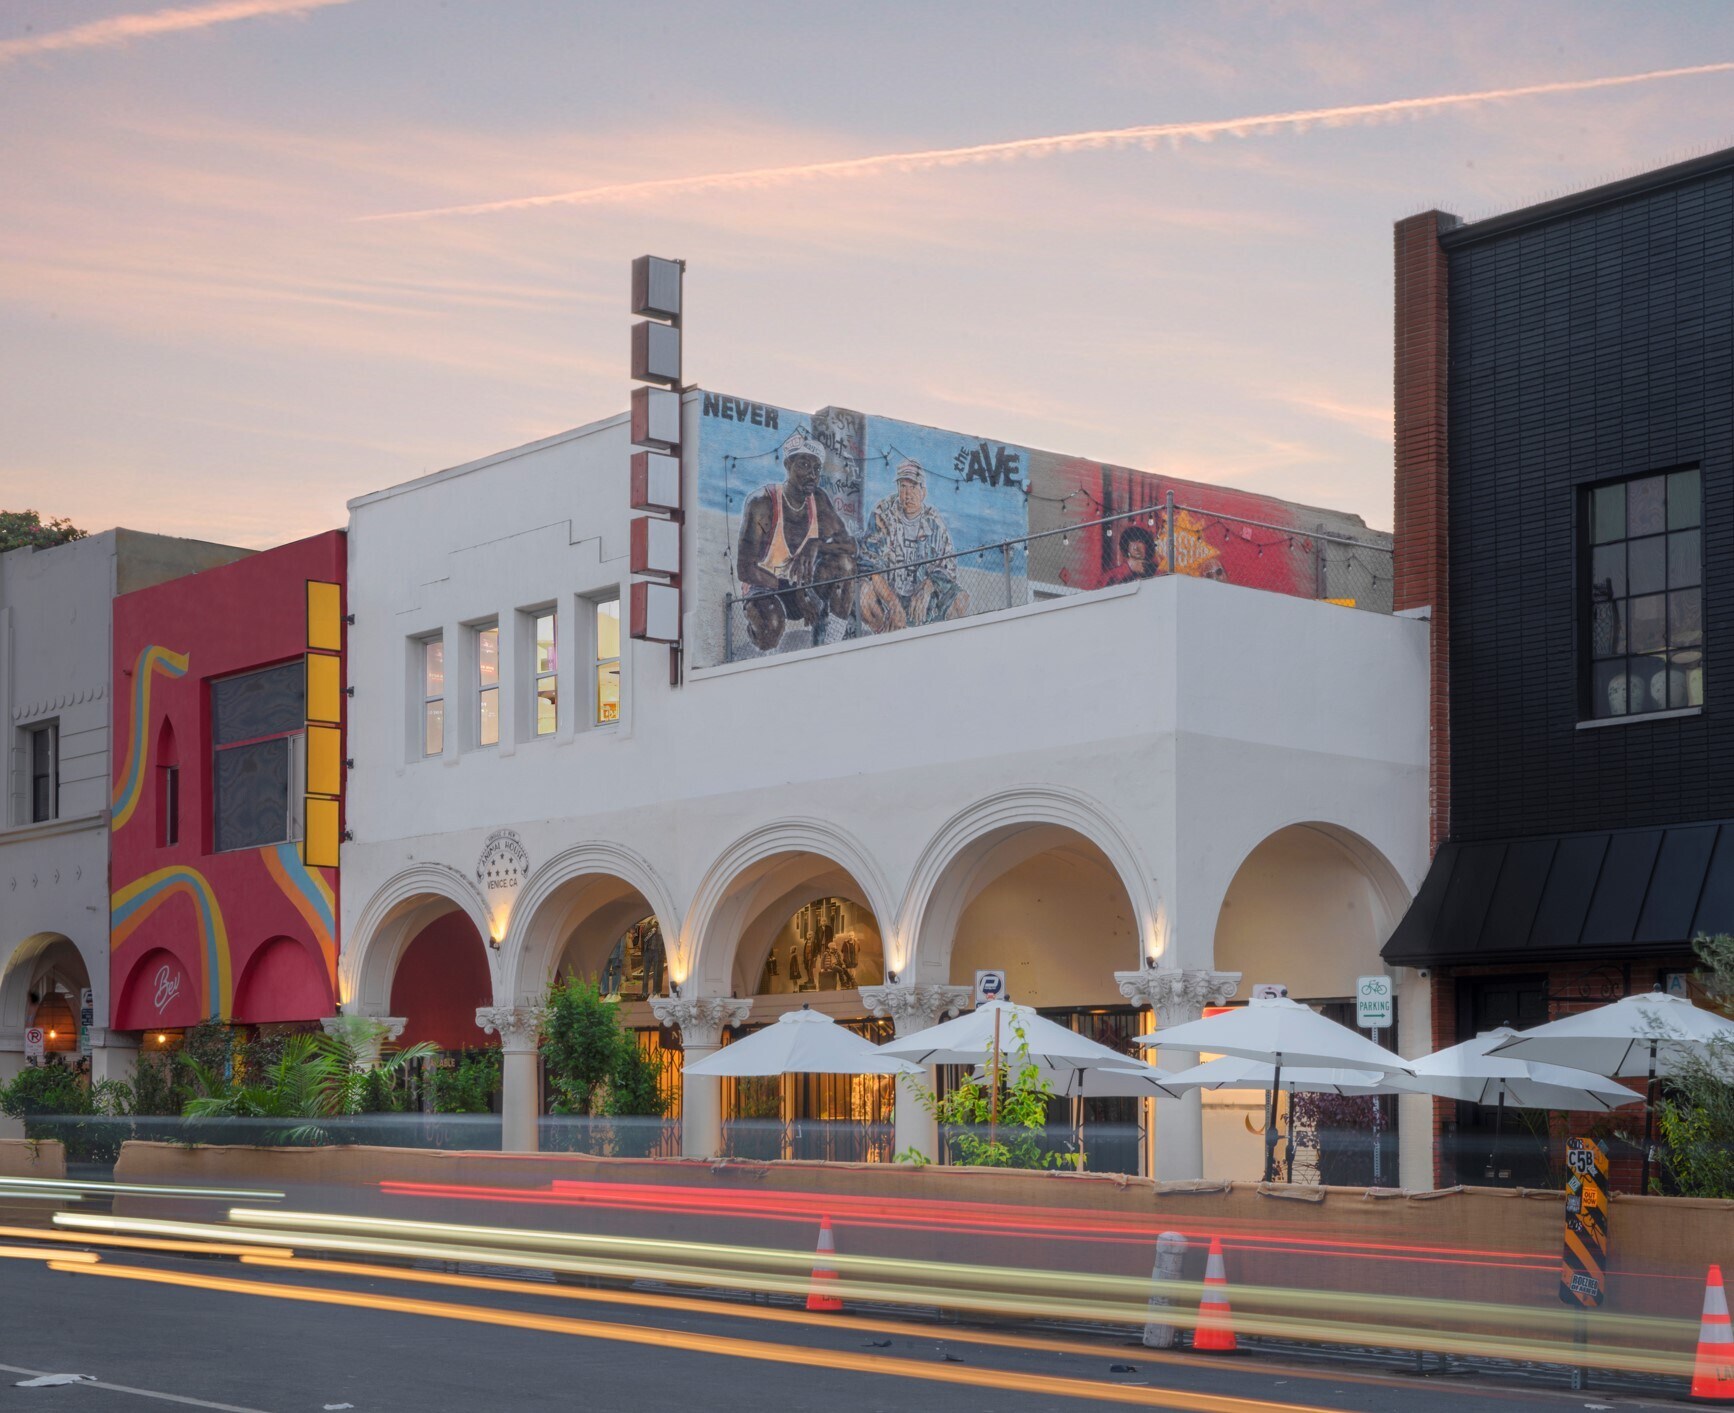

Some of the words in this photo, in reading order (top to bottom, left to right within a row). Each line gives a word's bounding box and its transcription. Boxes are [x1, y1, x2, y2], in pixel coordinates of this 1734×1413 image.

[703, 392, 779, 430] NEVER
[966, 441, 1020, 487] AVE
[481, 842, 501, 867] ANIMAL
[504, 841, 524, 861] HOUSE
[509, 877, 518, 888] CA
[154, 965, 181, 1010] Bev
[1670, 976, 1682, 990] A
[1359, 1001, 1390, 1011] PARKING
[1583, 1198, 1596, 1206] NOW
[1584, 1191, 1596, 1199] OUT
